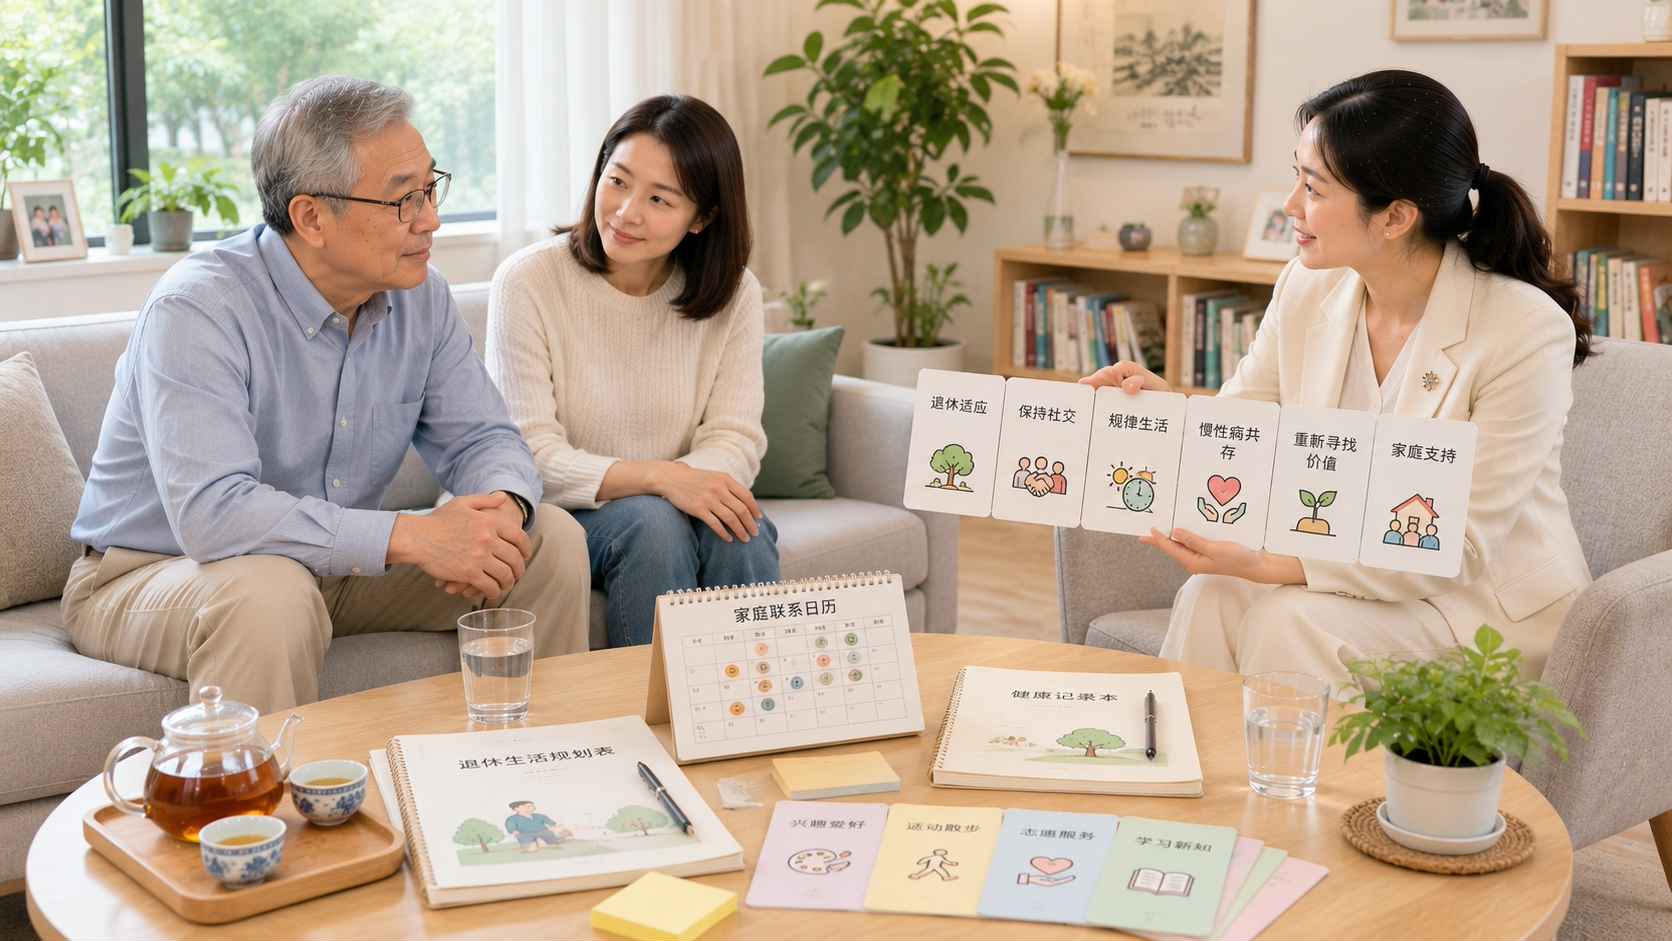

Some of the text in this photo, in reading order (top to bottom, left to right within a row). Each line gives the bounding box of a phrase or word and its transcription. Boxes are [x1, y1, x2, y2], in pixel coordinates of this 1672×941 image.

[930, 395, 988, 415] 退休适应
[1018, 404, 1077, 424] 保持社交
[1108, 412, 1169, 433] 规律生活
[1199, 422, 1261, 443] 慢性病共
[1293, 431, 1358, 453] 重新寻找
[1220, 444, 1236, 461] 存
[1306, 453, 1337, 472] 价值
[1391, 442, 1457, 464] 家庭支持
[734, 599, 837, 624] 家庭联系日历
[1011, 689, 1119, 702] 健康记录本
[458, 746, 616, 770] 退休生活规划表
[1135, 835, 1213, 853] 学习新知
